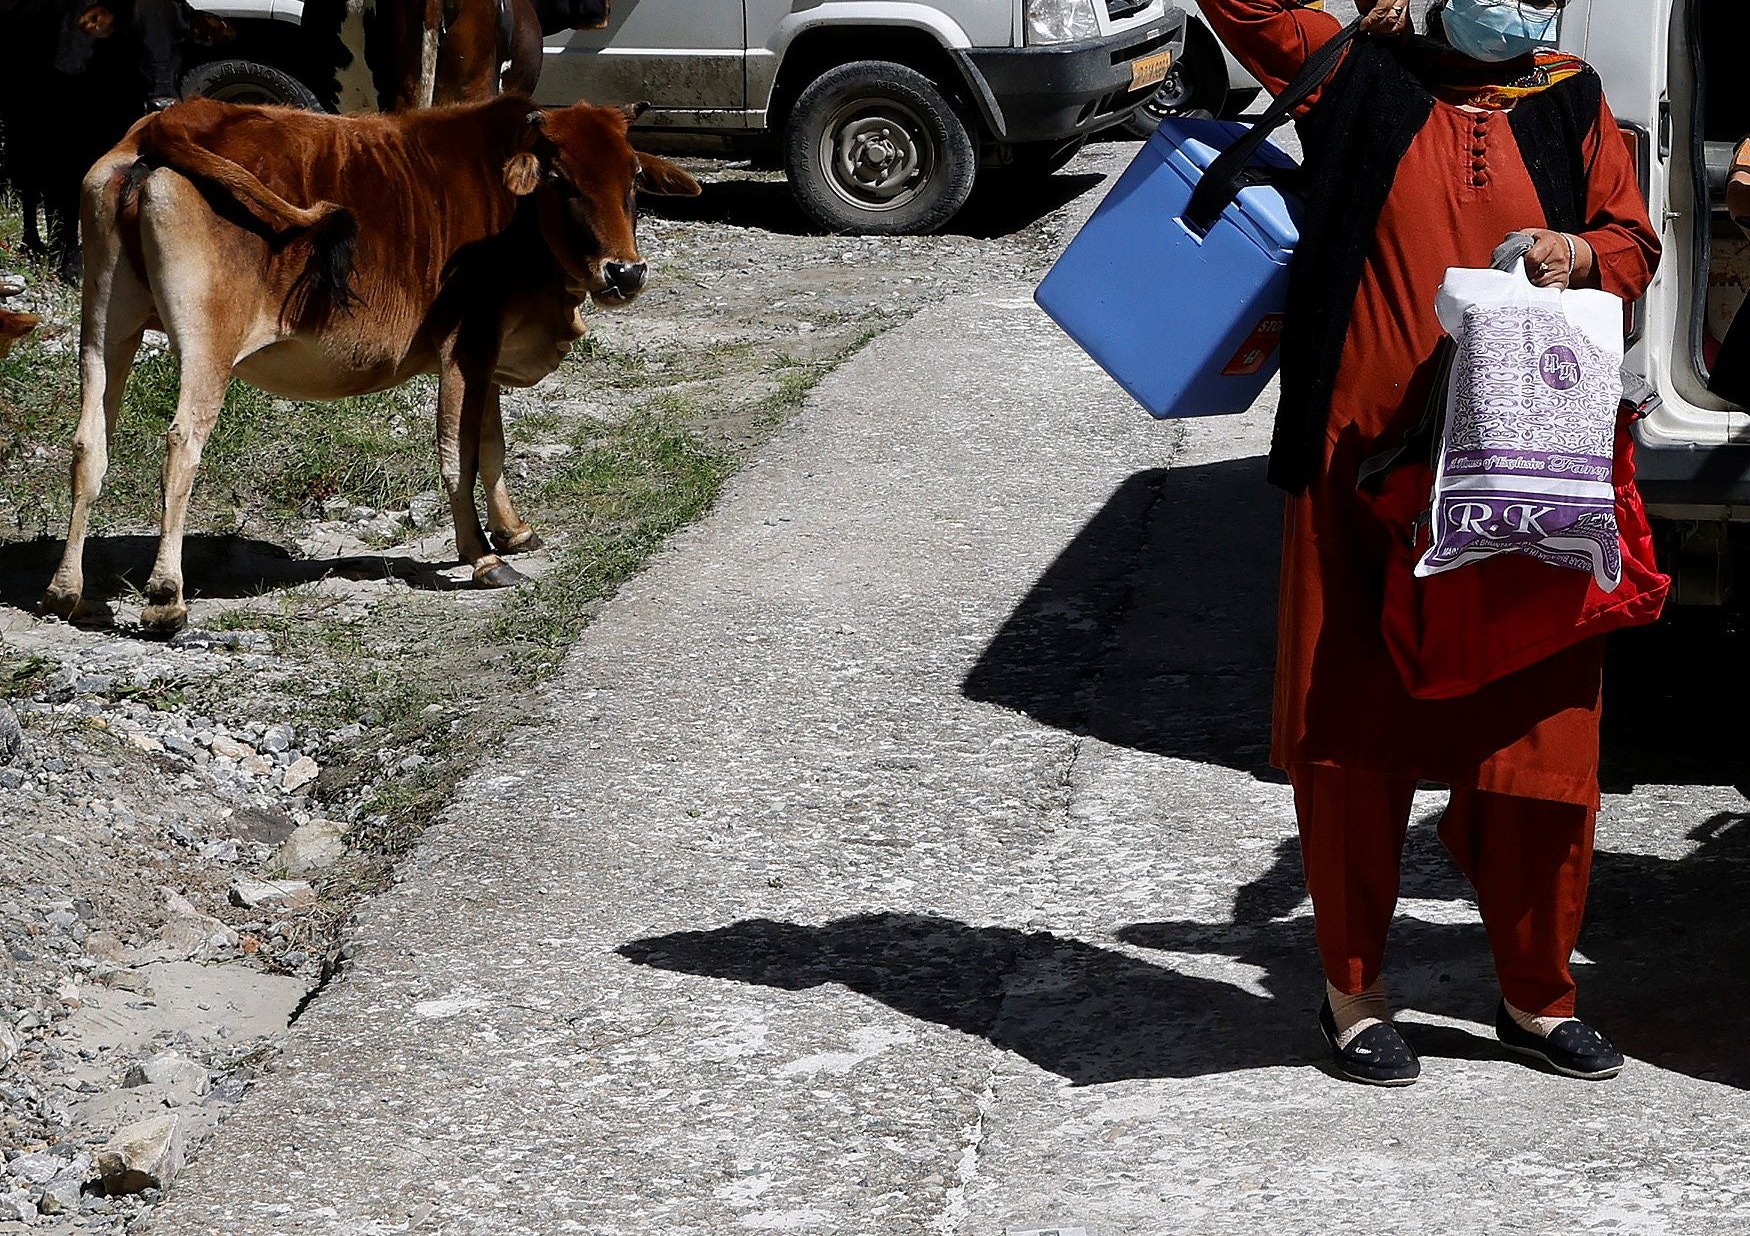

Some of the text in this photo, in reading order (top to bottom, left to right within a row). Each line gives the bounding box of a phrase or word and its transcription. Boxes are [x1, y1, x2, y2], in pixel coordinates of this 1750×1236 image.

[1482, 454, 1497, 471] of
[1495, 456, 1545, 471] Exclusive
[1548, 454, 1610, 482] Fancy
